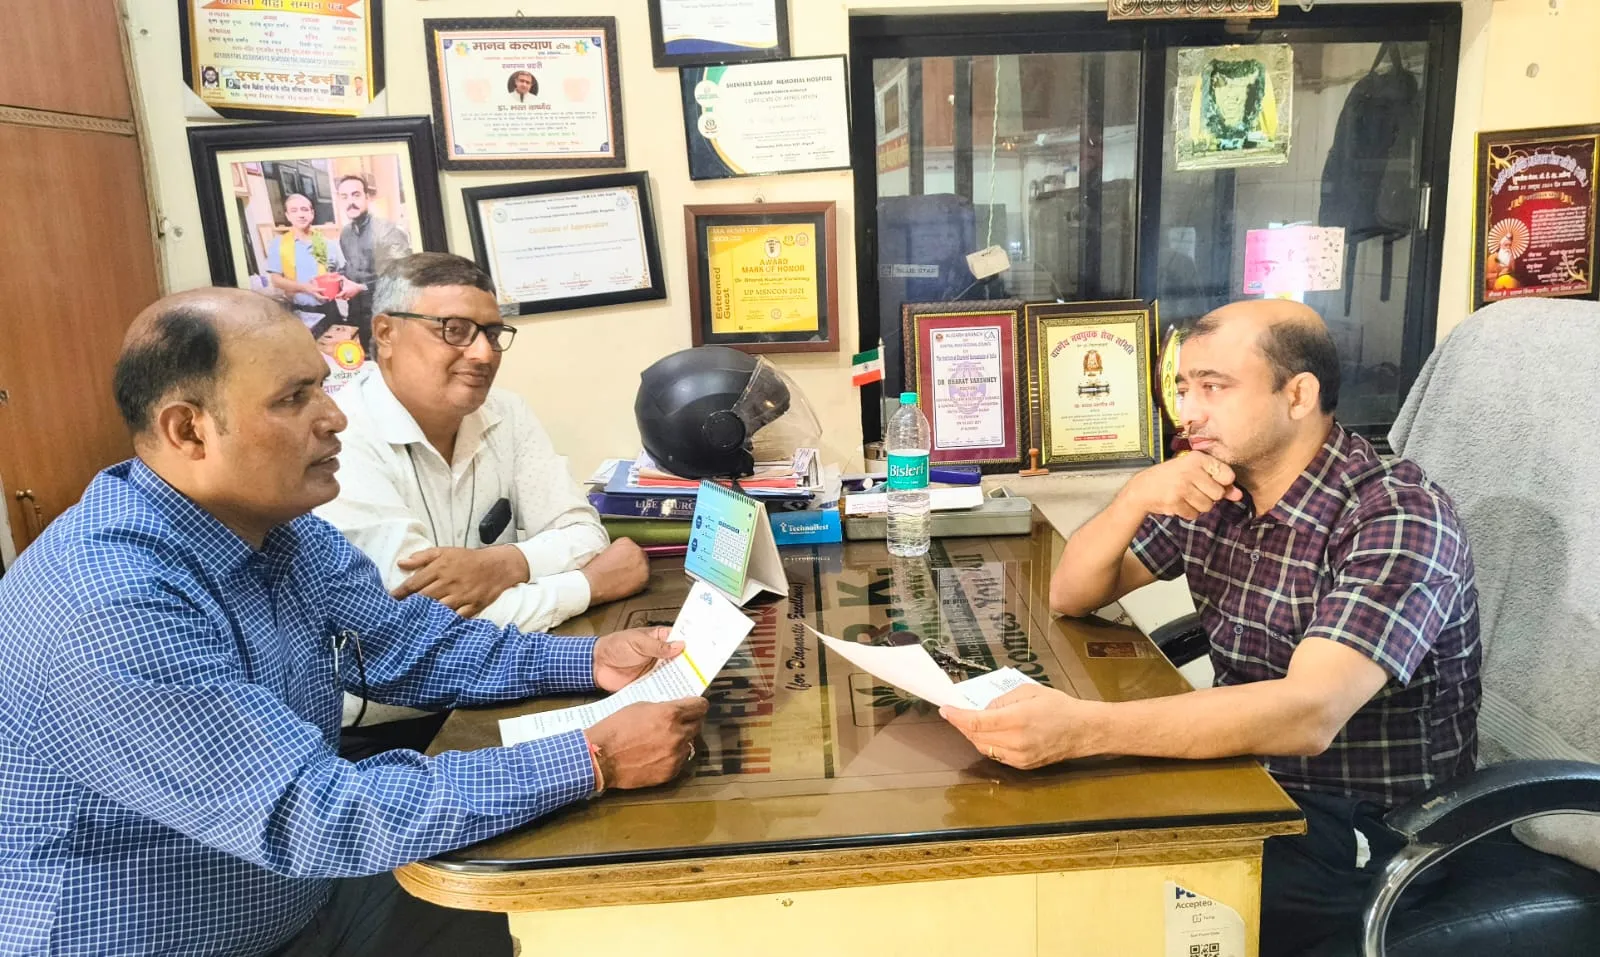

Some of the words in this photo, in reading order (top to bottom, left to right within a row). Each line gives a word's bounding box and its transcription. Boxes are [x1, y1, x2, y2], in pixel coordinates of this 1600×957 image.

[471, 41, 506, 51] मानव
[508, 40, 553, 50] कल्याण
[759, 258, 788, 266] AWARD
[777, 265, 805, 273] HONOR
[712, 267, 723, 320] Esteemed
[722, 287, 731, 320] Guest
[888, 462, 924, 478] Bisleri
[784, 622, 810, 670] Diagnostic
